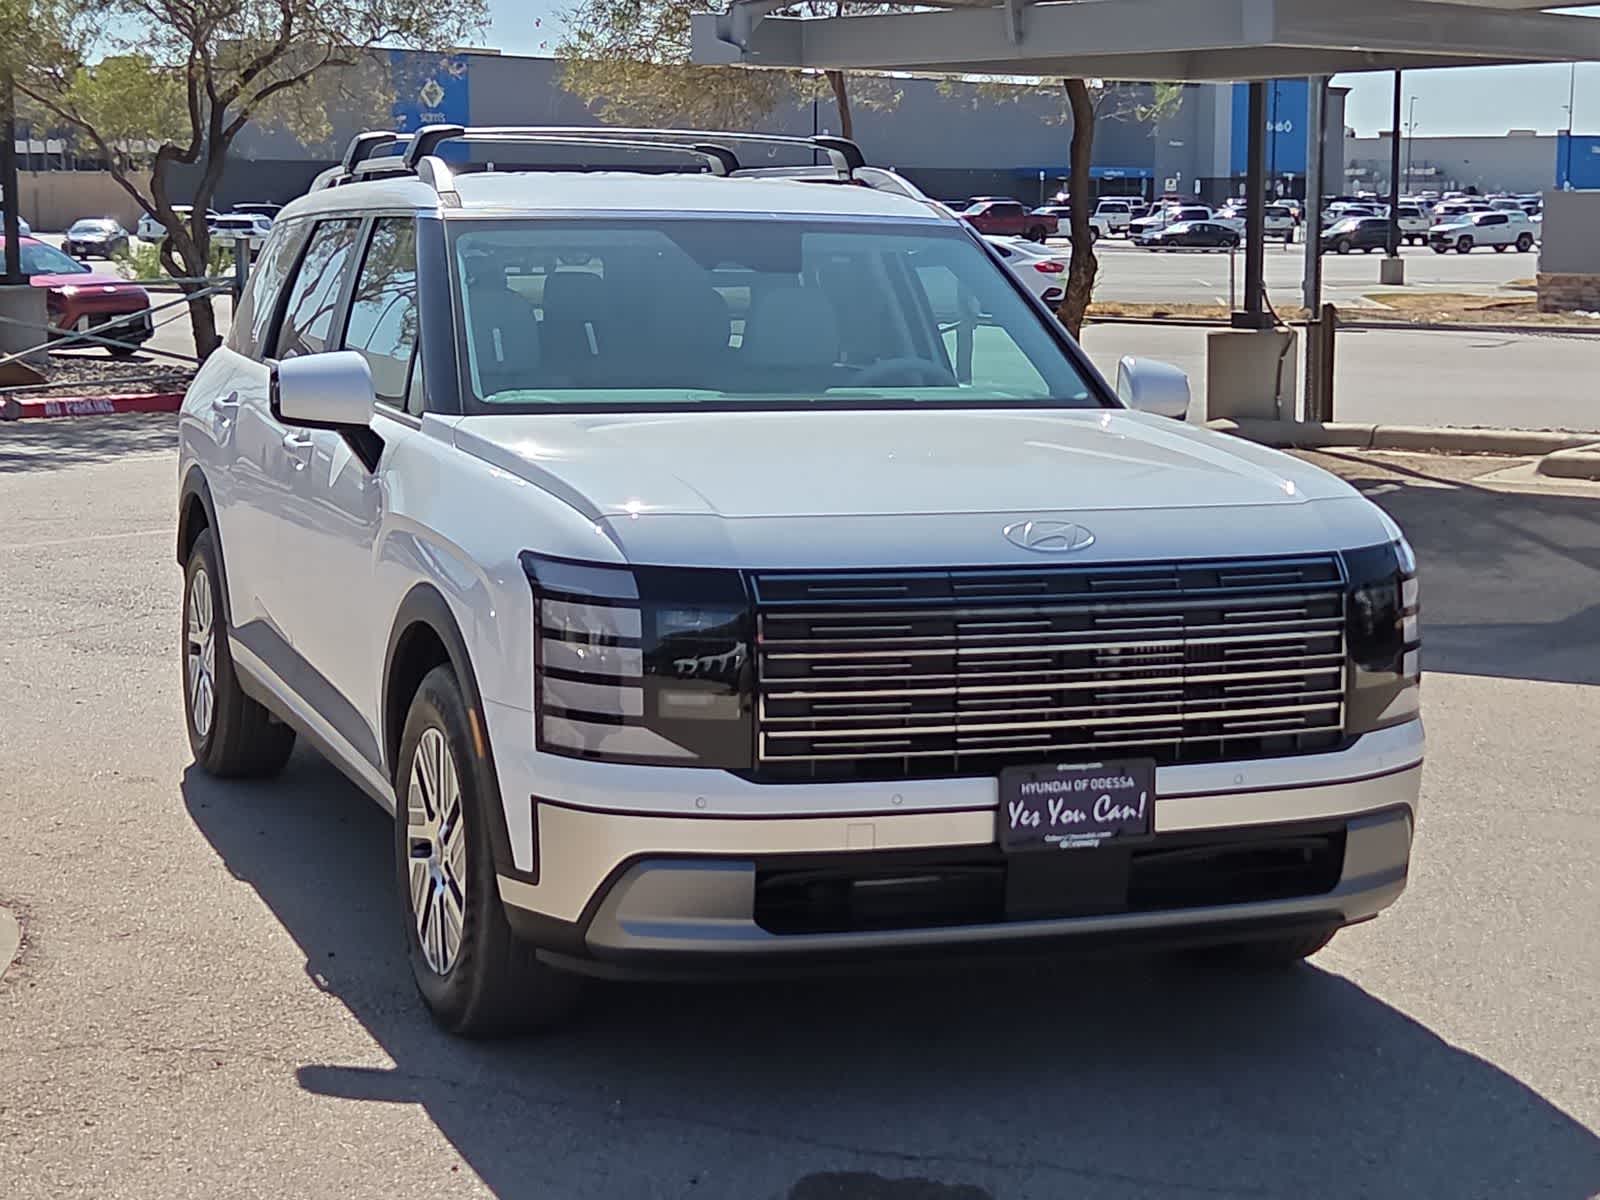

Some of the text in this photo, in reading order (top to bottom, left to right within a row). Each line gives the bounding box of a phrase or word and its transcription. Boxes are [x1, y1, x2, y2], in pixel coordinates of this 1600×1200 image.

[1021, 776, 1135, 795] HYUNDAI OF ODESSA
[1008, 791, 1147, 829] Yes You Can!
